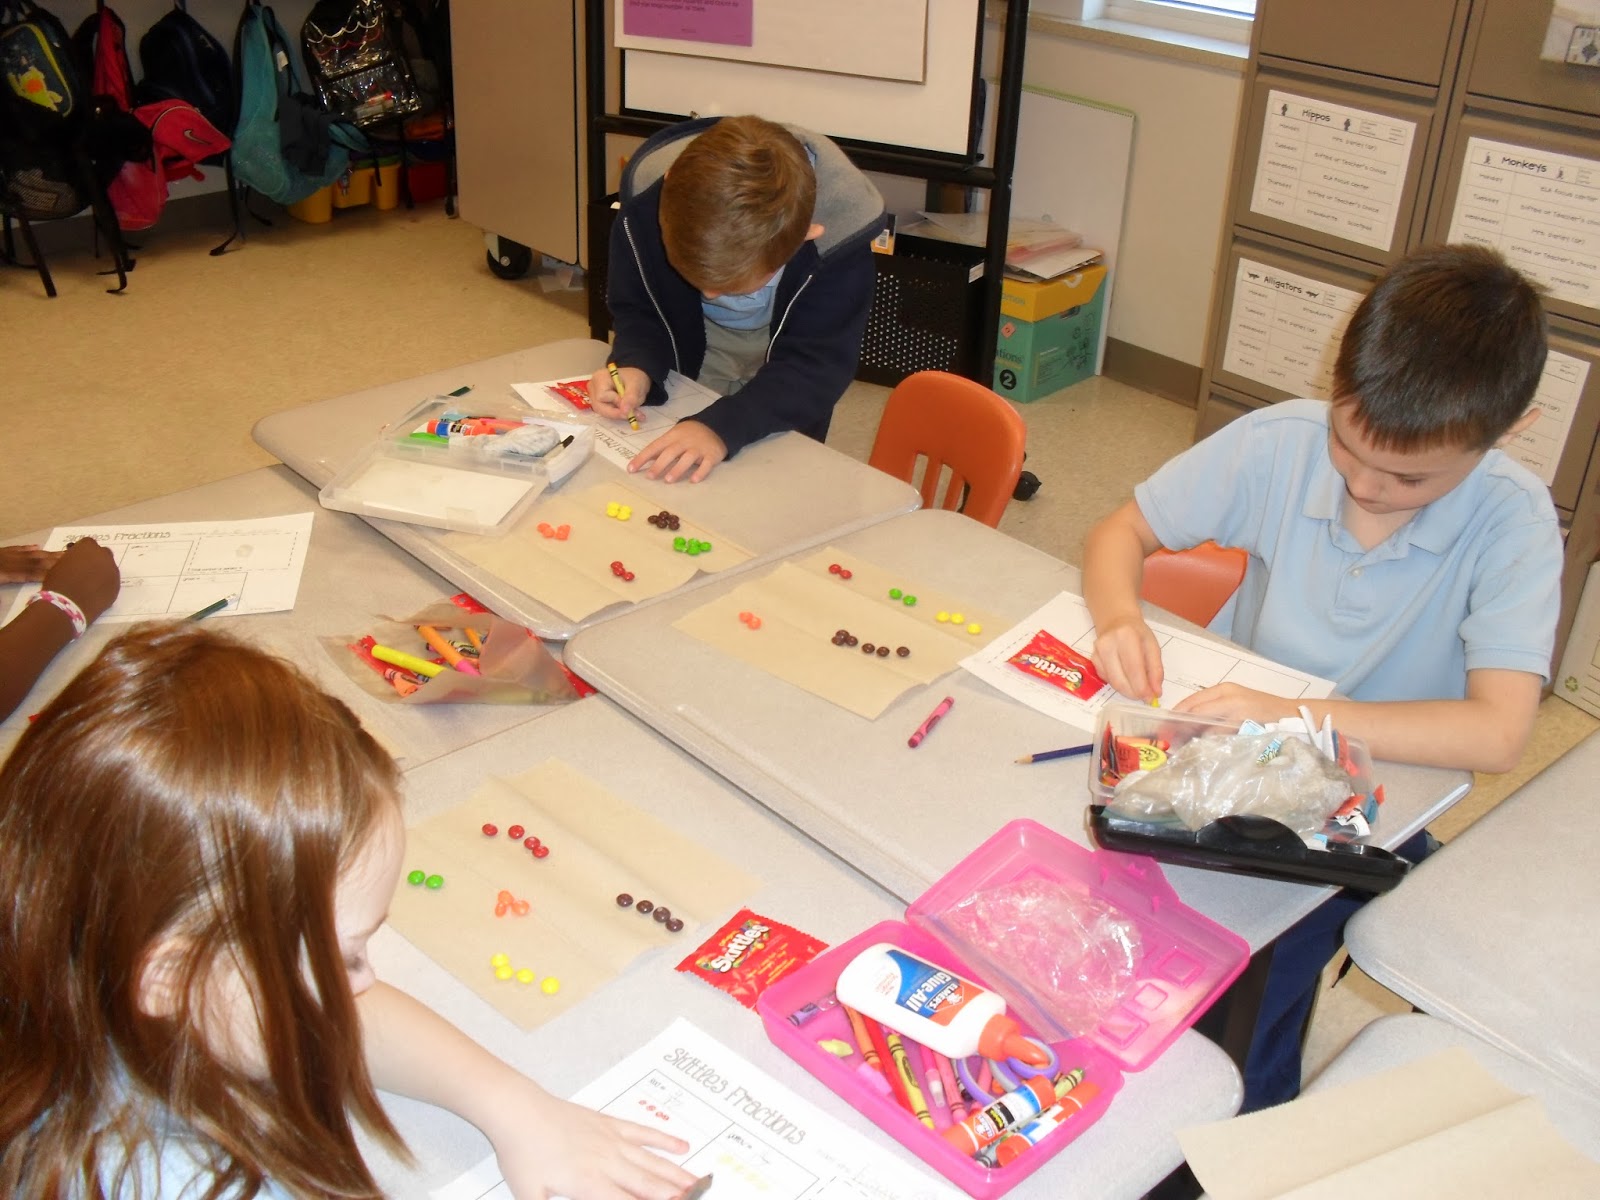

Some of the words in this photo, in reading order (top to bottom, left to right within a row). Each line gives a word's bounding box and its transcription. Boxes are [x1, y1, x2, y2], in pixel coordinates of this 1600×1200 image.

[1302, 109, 1330, 122] Hippos
[1501, 156, 1547, 173] Monkeys
[1264, 276, 1302, 294] Alligators
[113, 531, 171, 541] Fractions
[1021, 653, 1083, 683] Skittles
[711, 923, 771, 973] Skittles
[906, 971, 952, 1012] Glue-All
[663, 1047, 728, 1094] Skittles
[725, 1086, 806, 1145] Fractions
